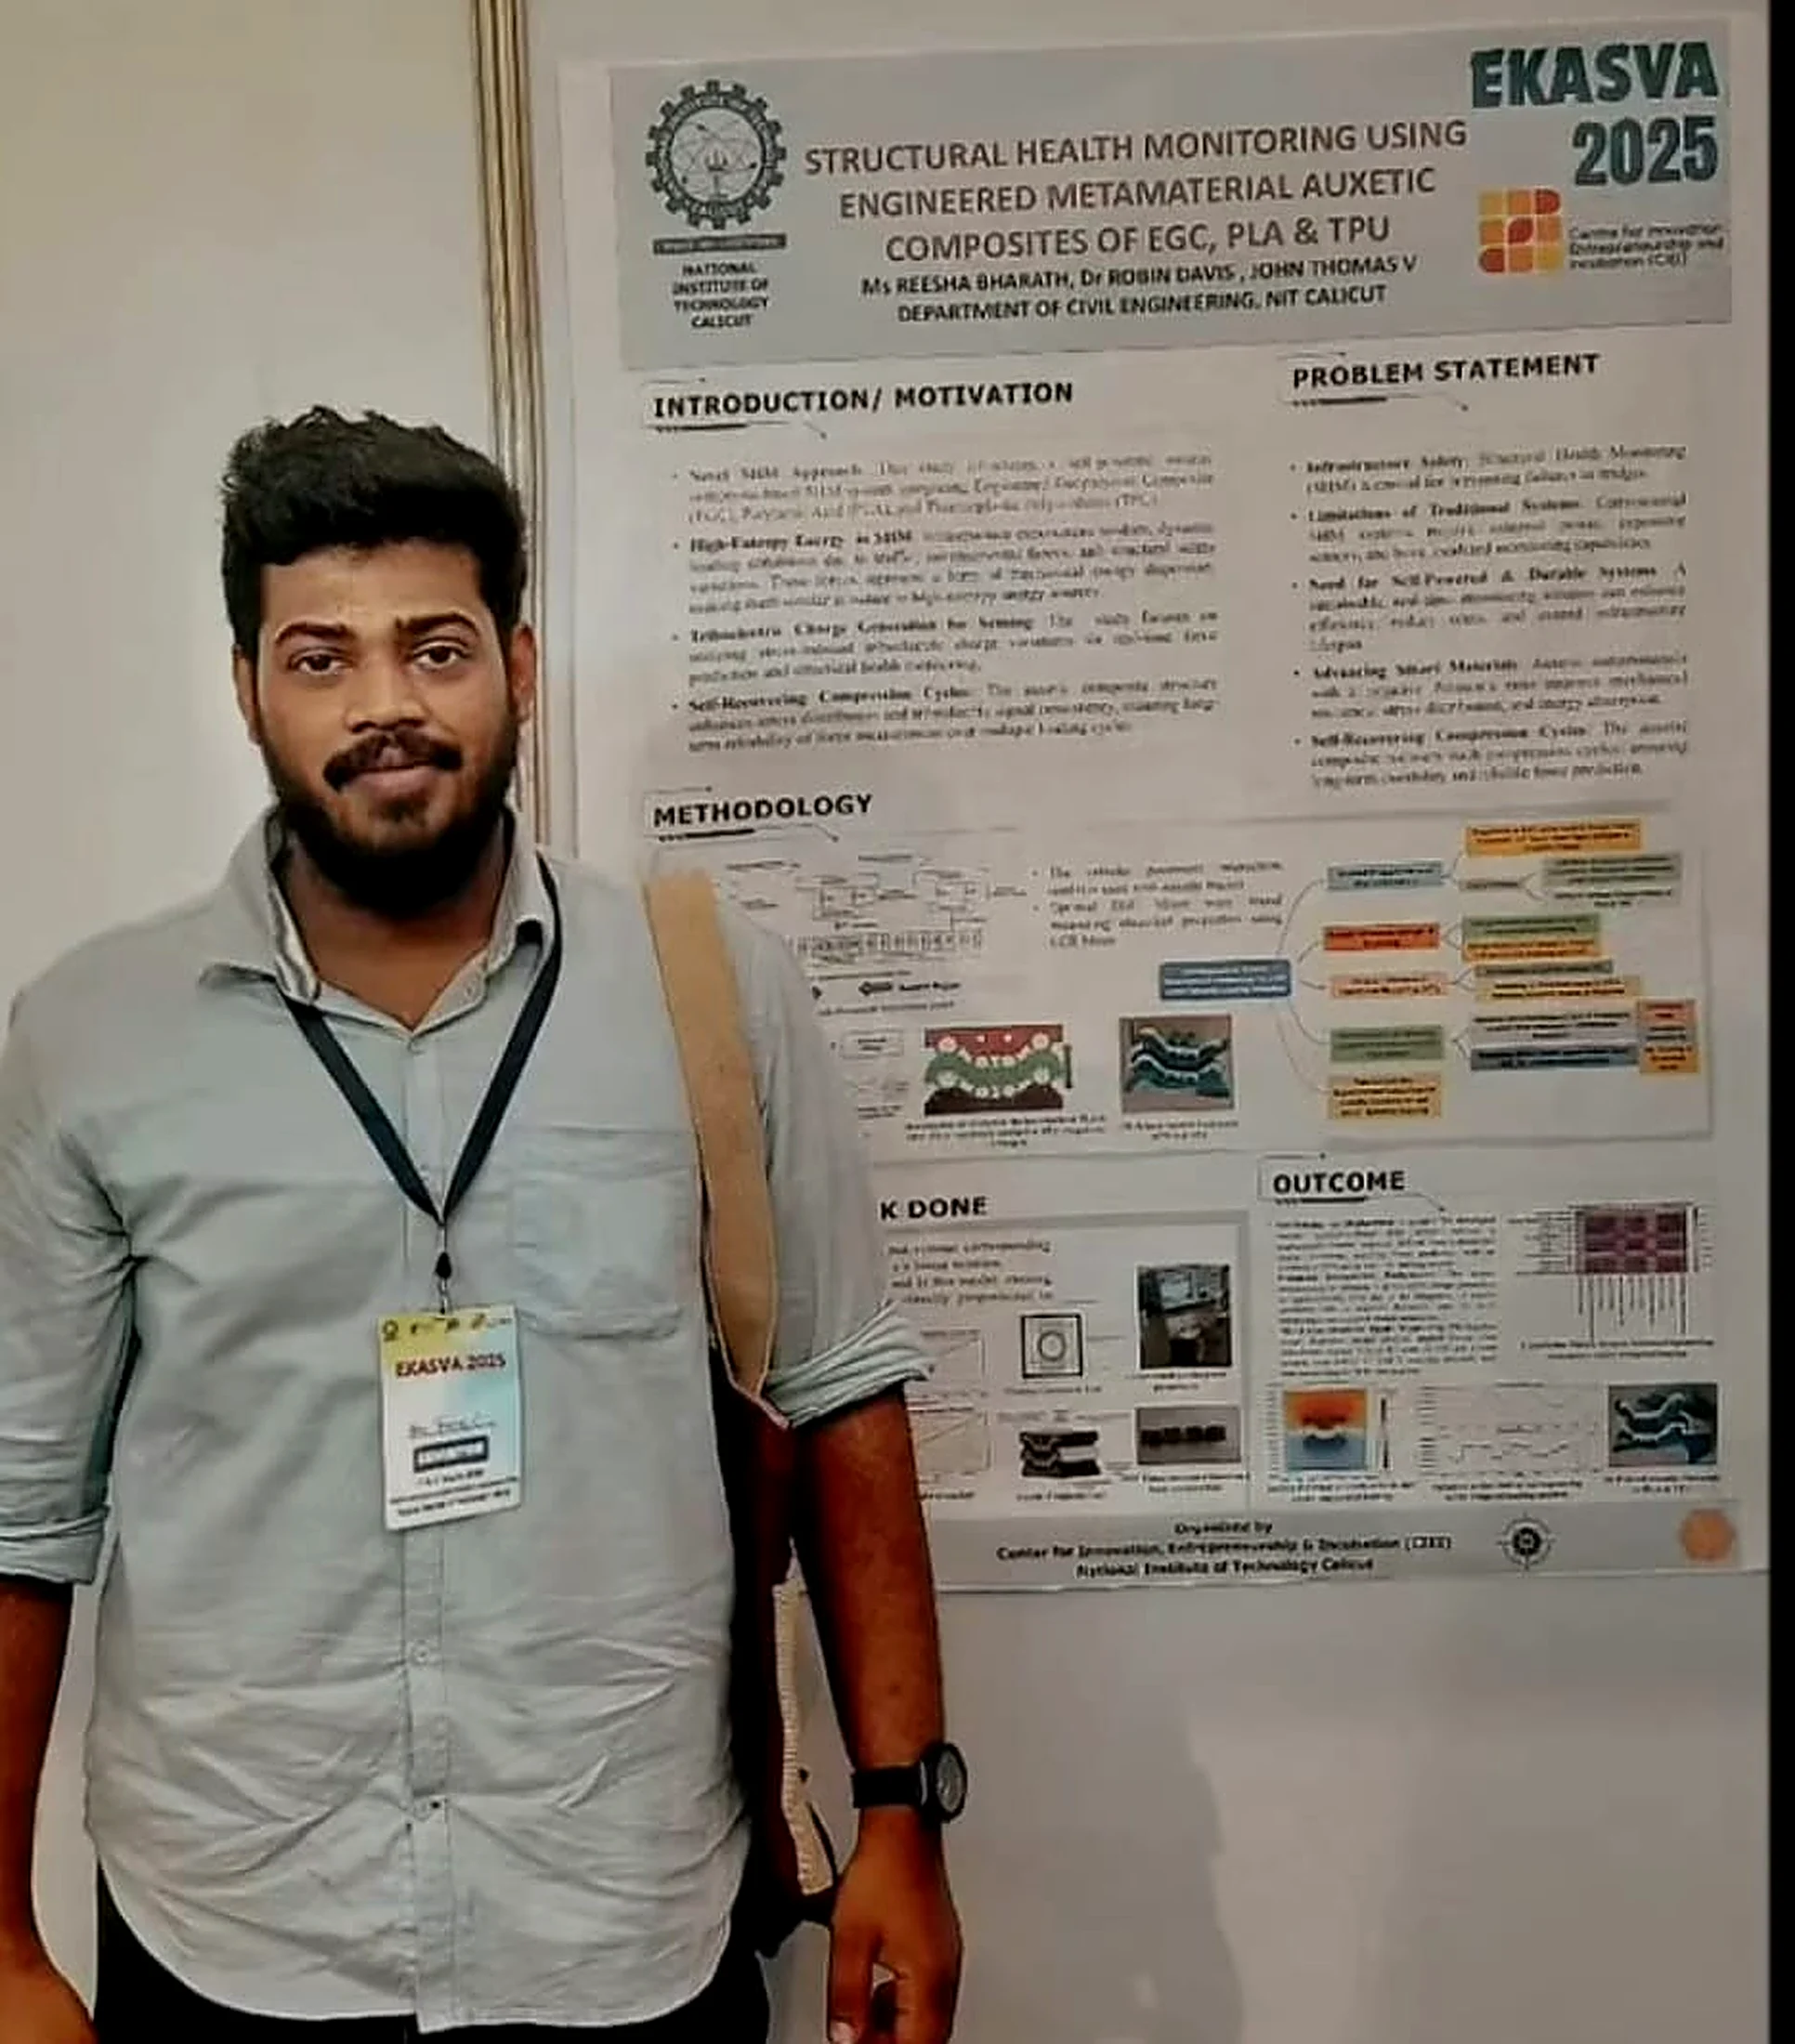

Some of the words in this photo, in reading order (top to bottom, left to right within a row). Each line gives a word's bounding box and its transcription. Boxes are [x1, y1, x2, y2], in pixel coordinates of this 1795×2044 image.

[1472, 42, 1719, 108] EKASVA
[805, 143, 1008, 175] STRUCTURAL
[1017, 136, 1133, 165] HEALTH
[1145, 124, 1356, 159] MONITORING
[1367, 120, 1467, 150] USING
[1572, 115, 1718, 186] 2025
[841, 186, 1037, 218] ENGINEERED
[1048, 175, 1293, 210] METAMATERIAL
[1302, 167, 1436, 198] AUXETIC
[886, 229, 1089, 261] COMPOSITES
[1097, 227, 1138, 253] OF
[1149, 224, 1217, 255] EGC,
[1227, 220, 1284, 248] PLA
[1294, 217, 1318, 244] &
[1329, 216, 1390, 242] TPU
[673, 280, 746, 295] INSTITUTE
[751, 278, 768, 291] OF
[683, 263, 757, 276] NATIONAL
[861, 278, 891, 295] Ms
[897, 275, 971, 295] REESHA
[976, 271, 1074, 292] BHARATH,
[1081, 269, 1105, 287] Dr
[1108, 267, 1170, 286] ROBIN
[1251, 260, 1304, 280] JOHN
[1312, 256, 1398, 277] THOMAS
[1401, 255, 1418, 273] V
[674, 296, 769, 311] TECHNOLOGY
[898, 300, 1031, 322] DEPARTMENT
[1036, 298, 1062, 318] OF
[1067, 297, 1115, 317] CIVIL
[1120, 291, 1260, 314] ENGINEERING,
[1265, 289, 1300, 308] NIT
[1305, 285, 1387, 307] CALICUT
[1293, 362, 1423, 387] PROBLEM
[1434, 353, 1601, 381] STATEMENT
[654, 388, 883, 417] INTRODUCTION/
[895, 382, 1073, 408] MOTIVATION
[654, 794, 873, 827] METHODOLOGY
[1273, 1170, 1406, 1194] OUTCOME
[907, 1195, 988, 1219] DONE
[396, 1356, 463, 1379] EKASVA
[466, 1353, 507, 1370] 2025
